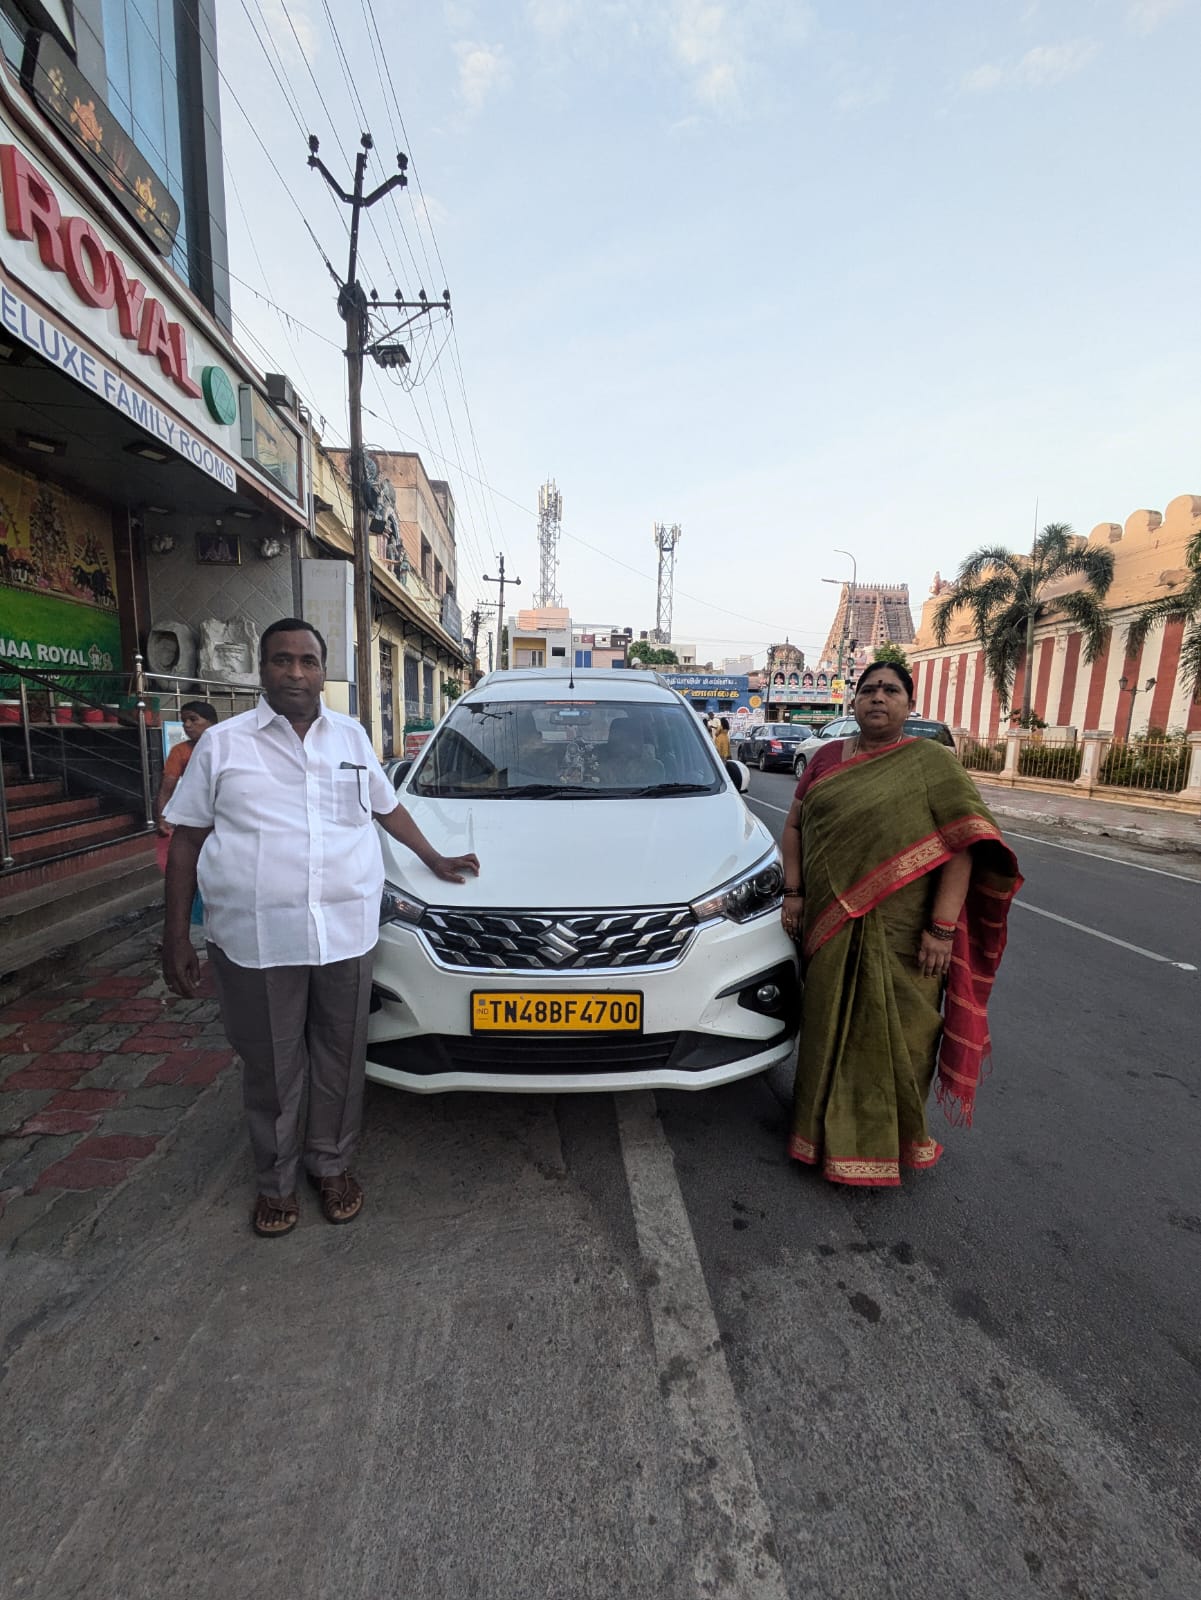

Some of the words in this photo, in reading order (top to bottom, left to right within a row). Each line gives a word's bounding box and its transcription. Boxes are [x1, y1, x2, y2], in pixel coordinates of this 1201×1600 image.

[0, 143, 202, 400] ROYAL
[103, 368, 176, 449] FAMILY
[180, 431, 235, 490] ROOMS
[37, 643, 89, 667] ROYAL
[489, 1000, 638, 1024] TN48BF4700
